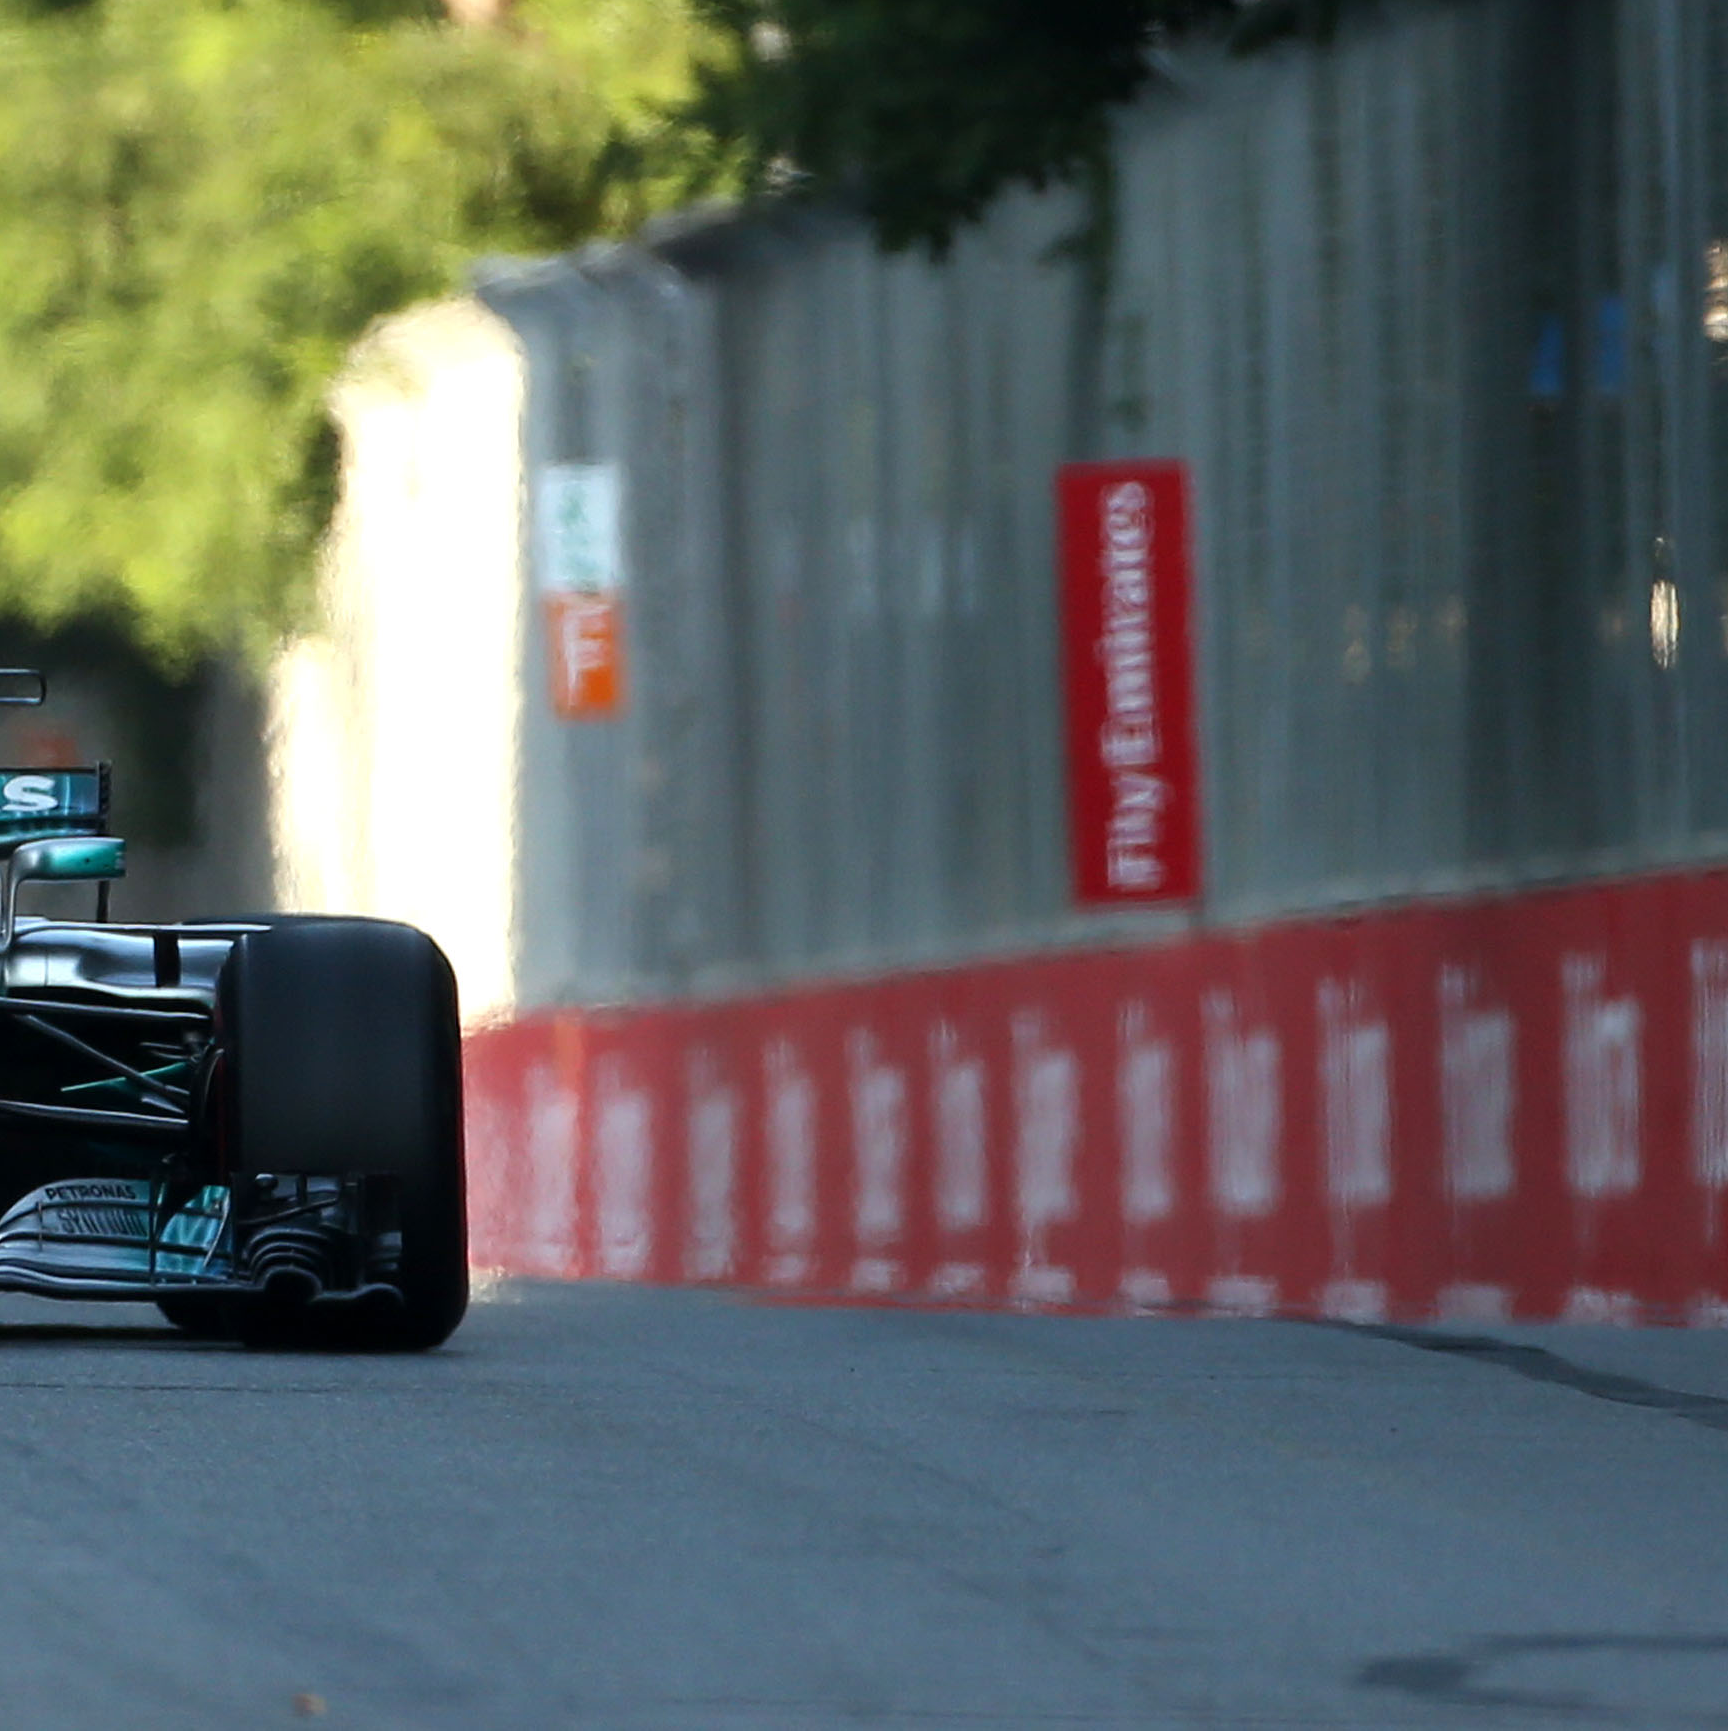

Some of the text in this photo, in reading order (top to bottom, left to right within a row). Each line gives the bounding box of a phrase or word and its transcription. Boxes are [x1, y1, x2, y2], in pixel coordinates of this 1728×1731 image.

[1098, 480, 1169, 890] Fly Emirates
[43, 1184, 137, 1201] PETRONAS
